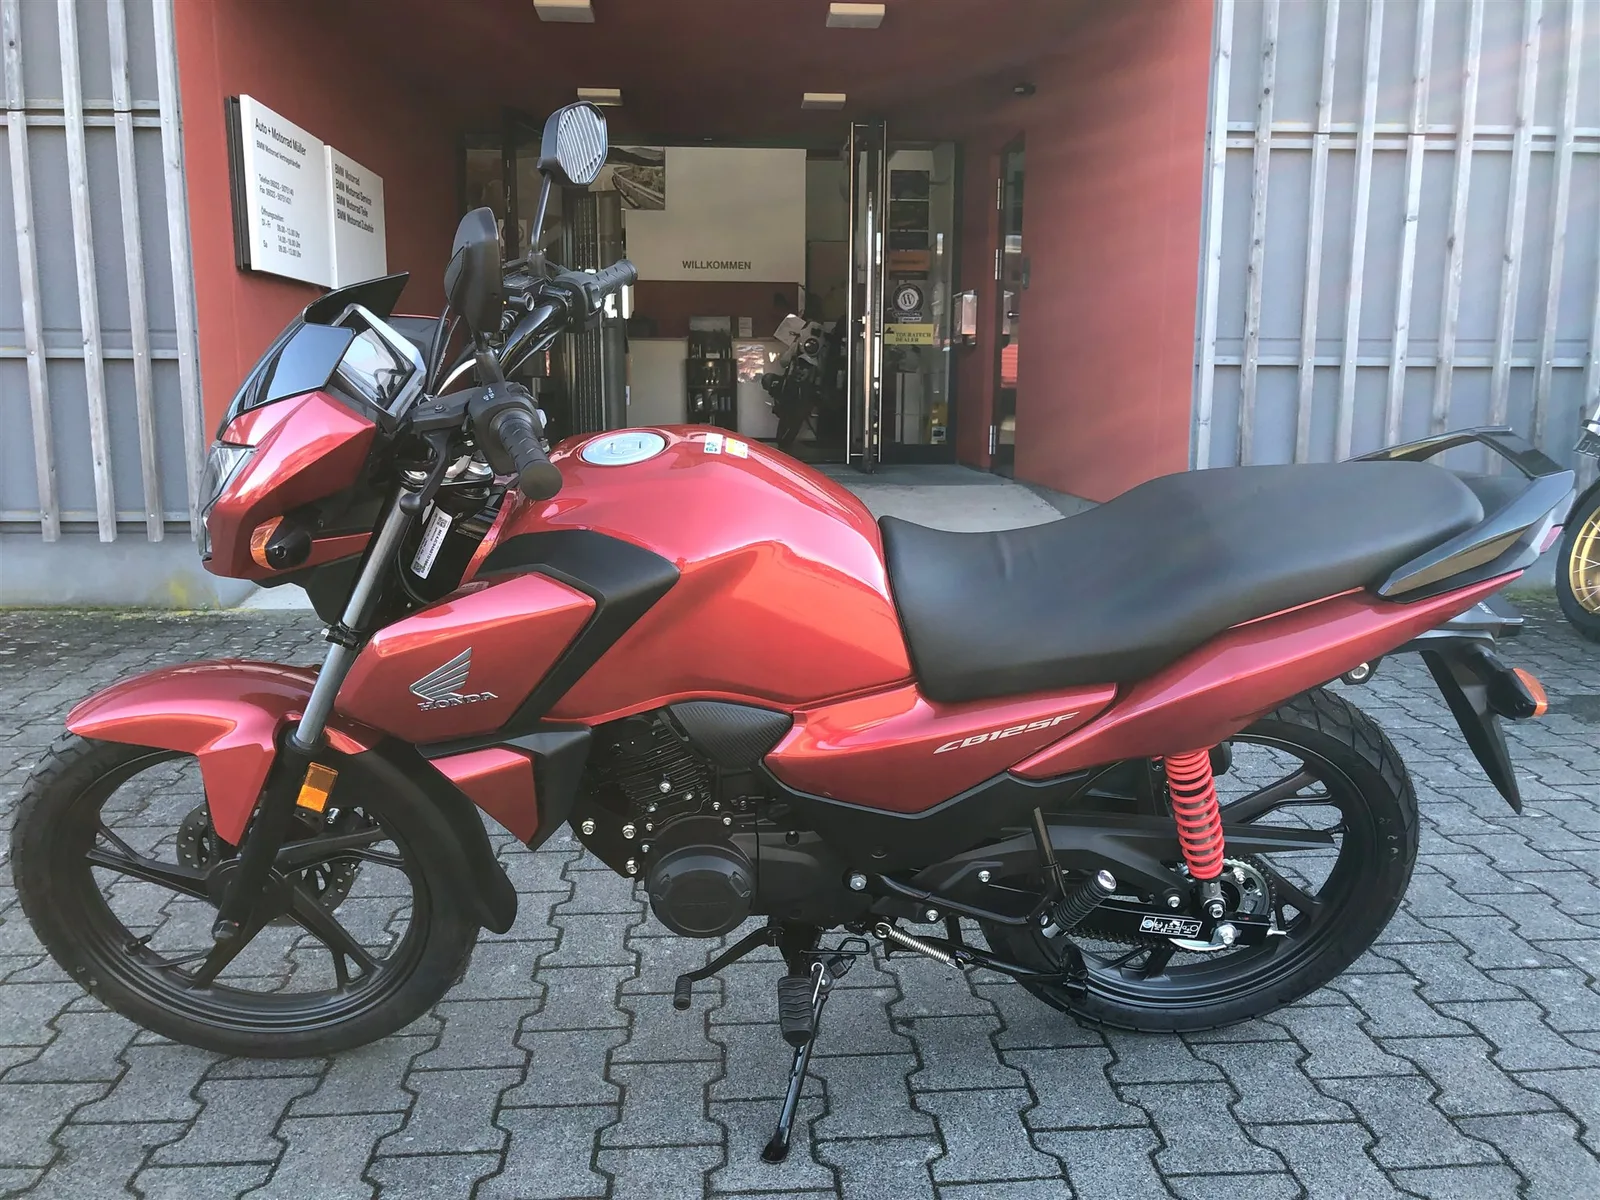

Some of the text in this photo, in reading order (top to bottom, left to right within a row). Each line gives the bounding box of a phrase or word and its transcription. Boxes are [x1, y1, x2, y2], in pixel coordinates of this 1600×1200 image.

[255, 118, 268, 135] Auto
[271, 127, 293, 149] Motorrad
[292, 139, 307, 156] Müller
[334, 163, 361, 187] BMW Motorrad
[335, 178, 345, 192] BMW
[345, 184, 361, 201] Motorrad
[336, 193, 346, 207] BMW
[345, 198, 361, 215] Motorrad
[337, 208, 347, 222] BMW
[346, 213, 362, 229] Motorrad
[681, 260, 752, 270] WILLKOMMEN
[417, 691, 499, 712] HONDA
[932, 711, 1081, 755] CB125F
